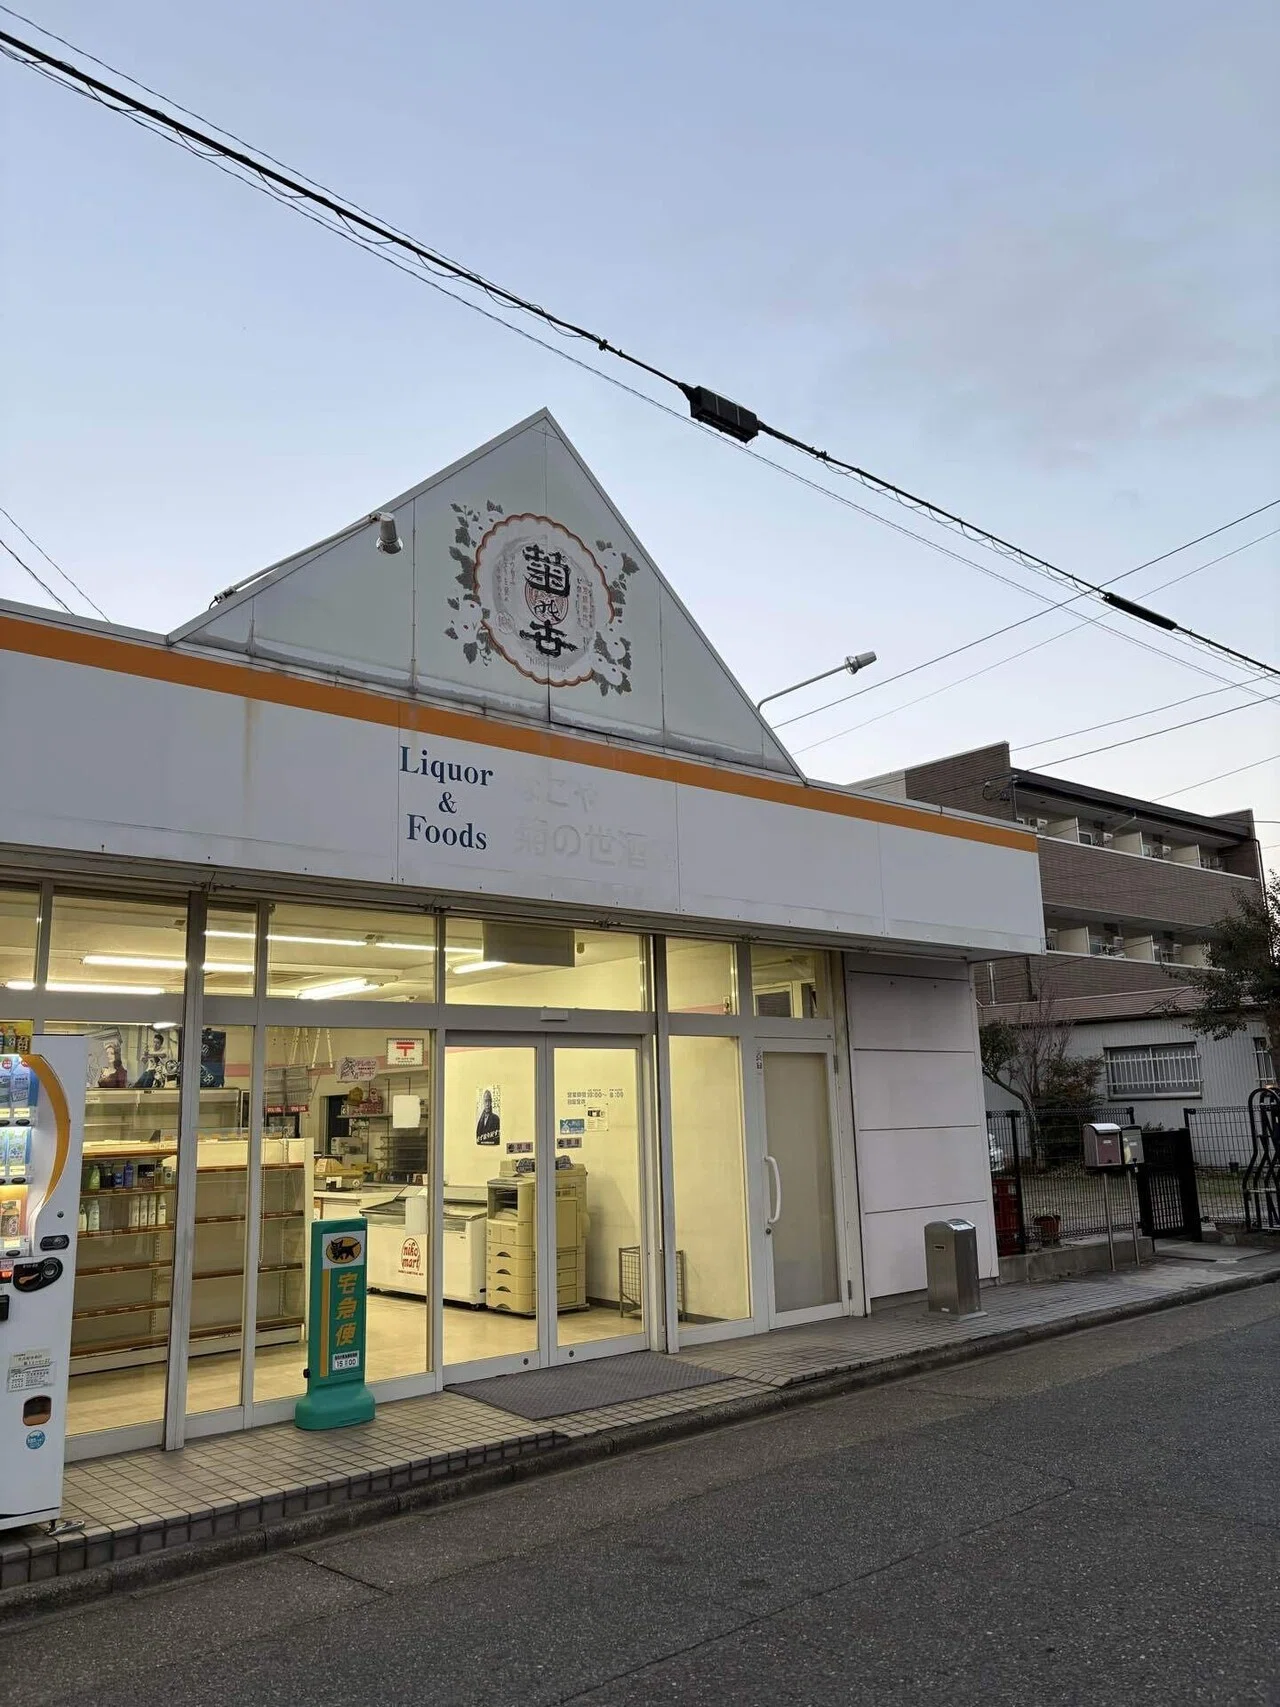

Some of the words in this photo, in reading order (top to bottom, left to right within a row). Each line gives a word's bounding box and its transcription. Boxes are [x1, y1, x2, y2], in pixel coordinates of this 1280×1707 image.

[400, 745, 494, 786] Liquor
[439, 792, 457, 813] &
[407, 813, 487, 850] Foods
[336, 1273, 358, 1347] 宅急便
